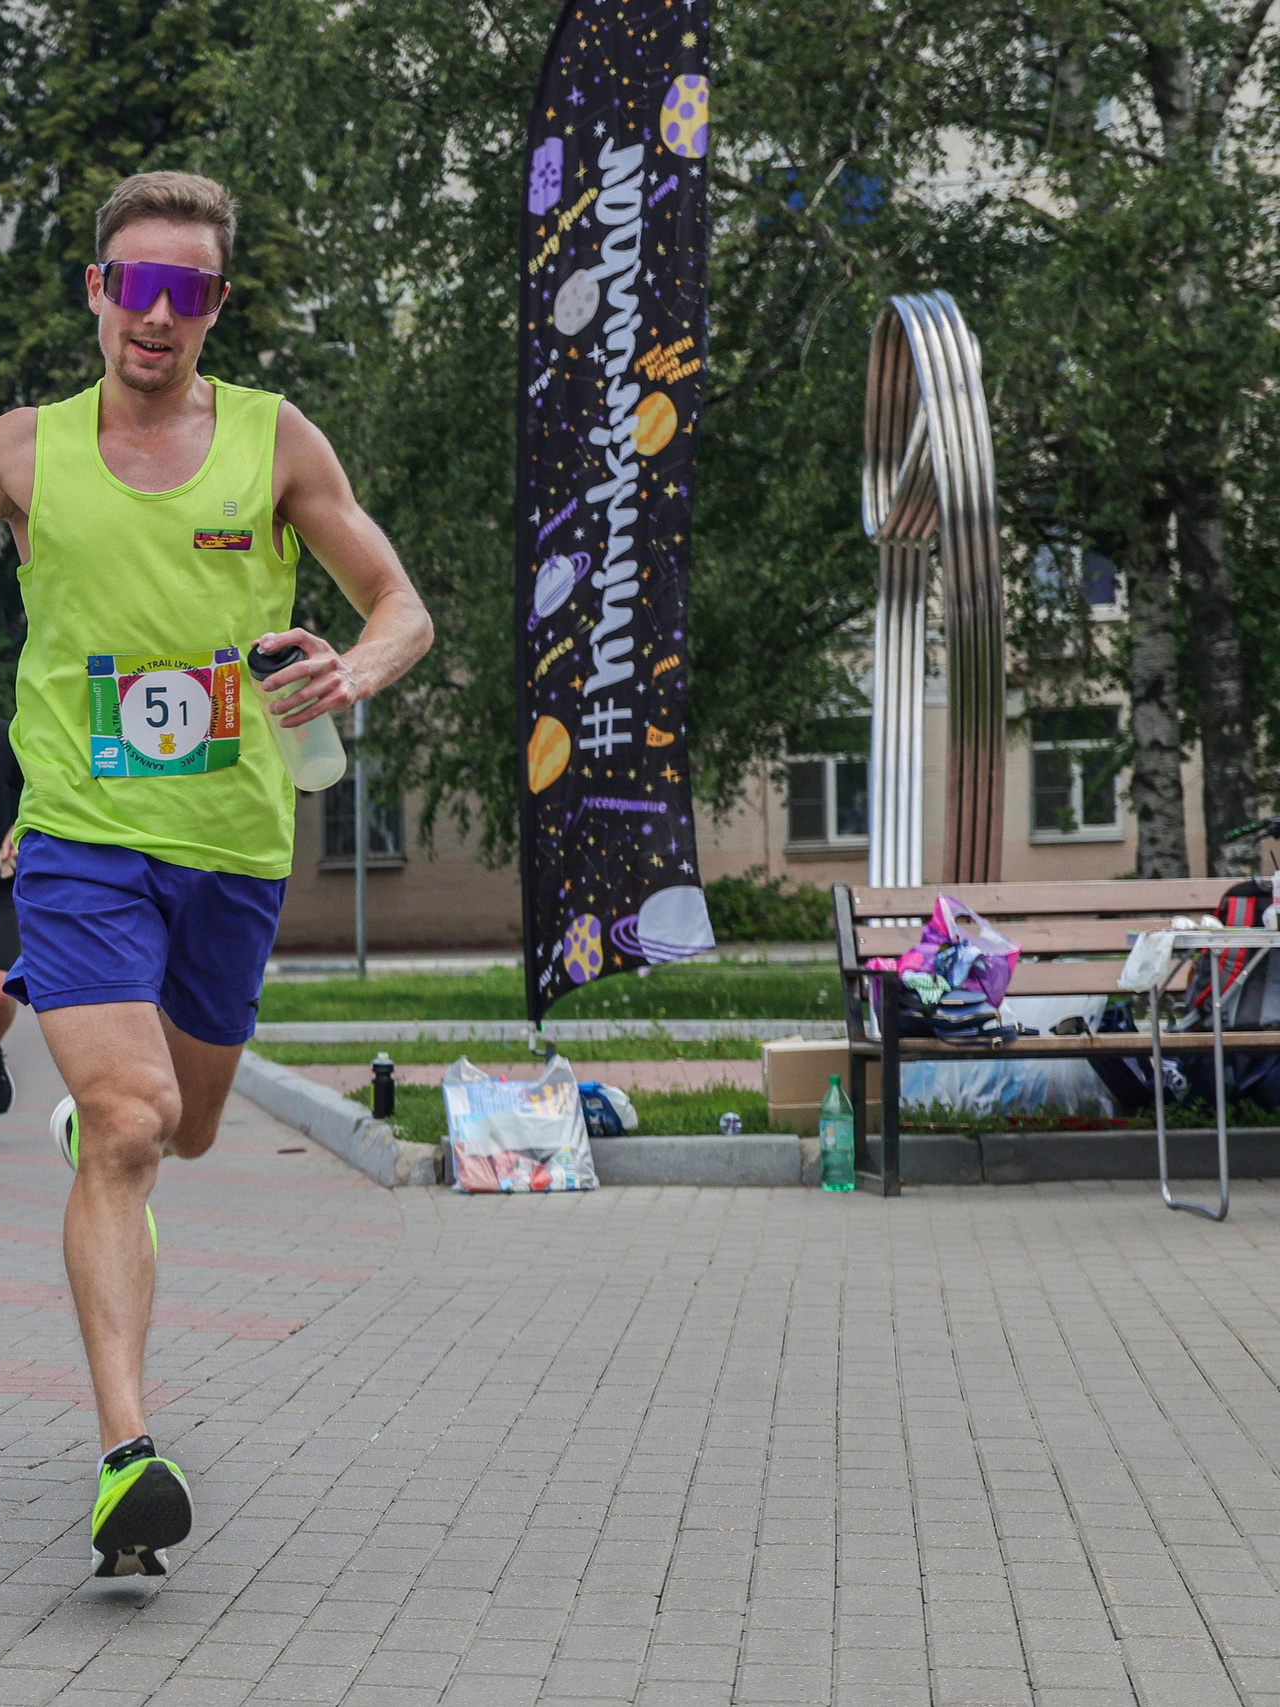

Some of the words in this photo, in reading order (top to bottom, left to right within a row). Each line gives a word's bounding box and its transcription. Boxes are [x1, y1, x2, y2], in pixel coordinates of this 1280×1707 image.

[119, 665, 147, 691] DREAM
[147, 659, 173, 670] TRAIL
[174, 659, 209, 684] LYSKOVO
[112, 701, 121, 726] TRAIL
[224, 674, 235, 730] ЭСТАФЕТА
[195, 694, 220, 758] ХИМКИНСКИЙ
[128, 750, 165, 771] KANNAS
[181, 755, 196, 768] ЛЕС
